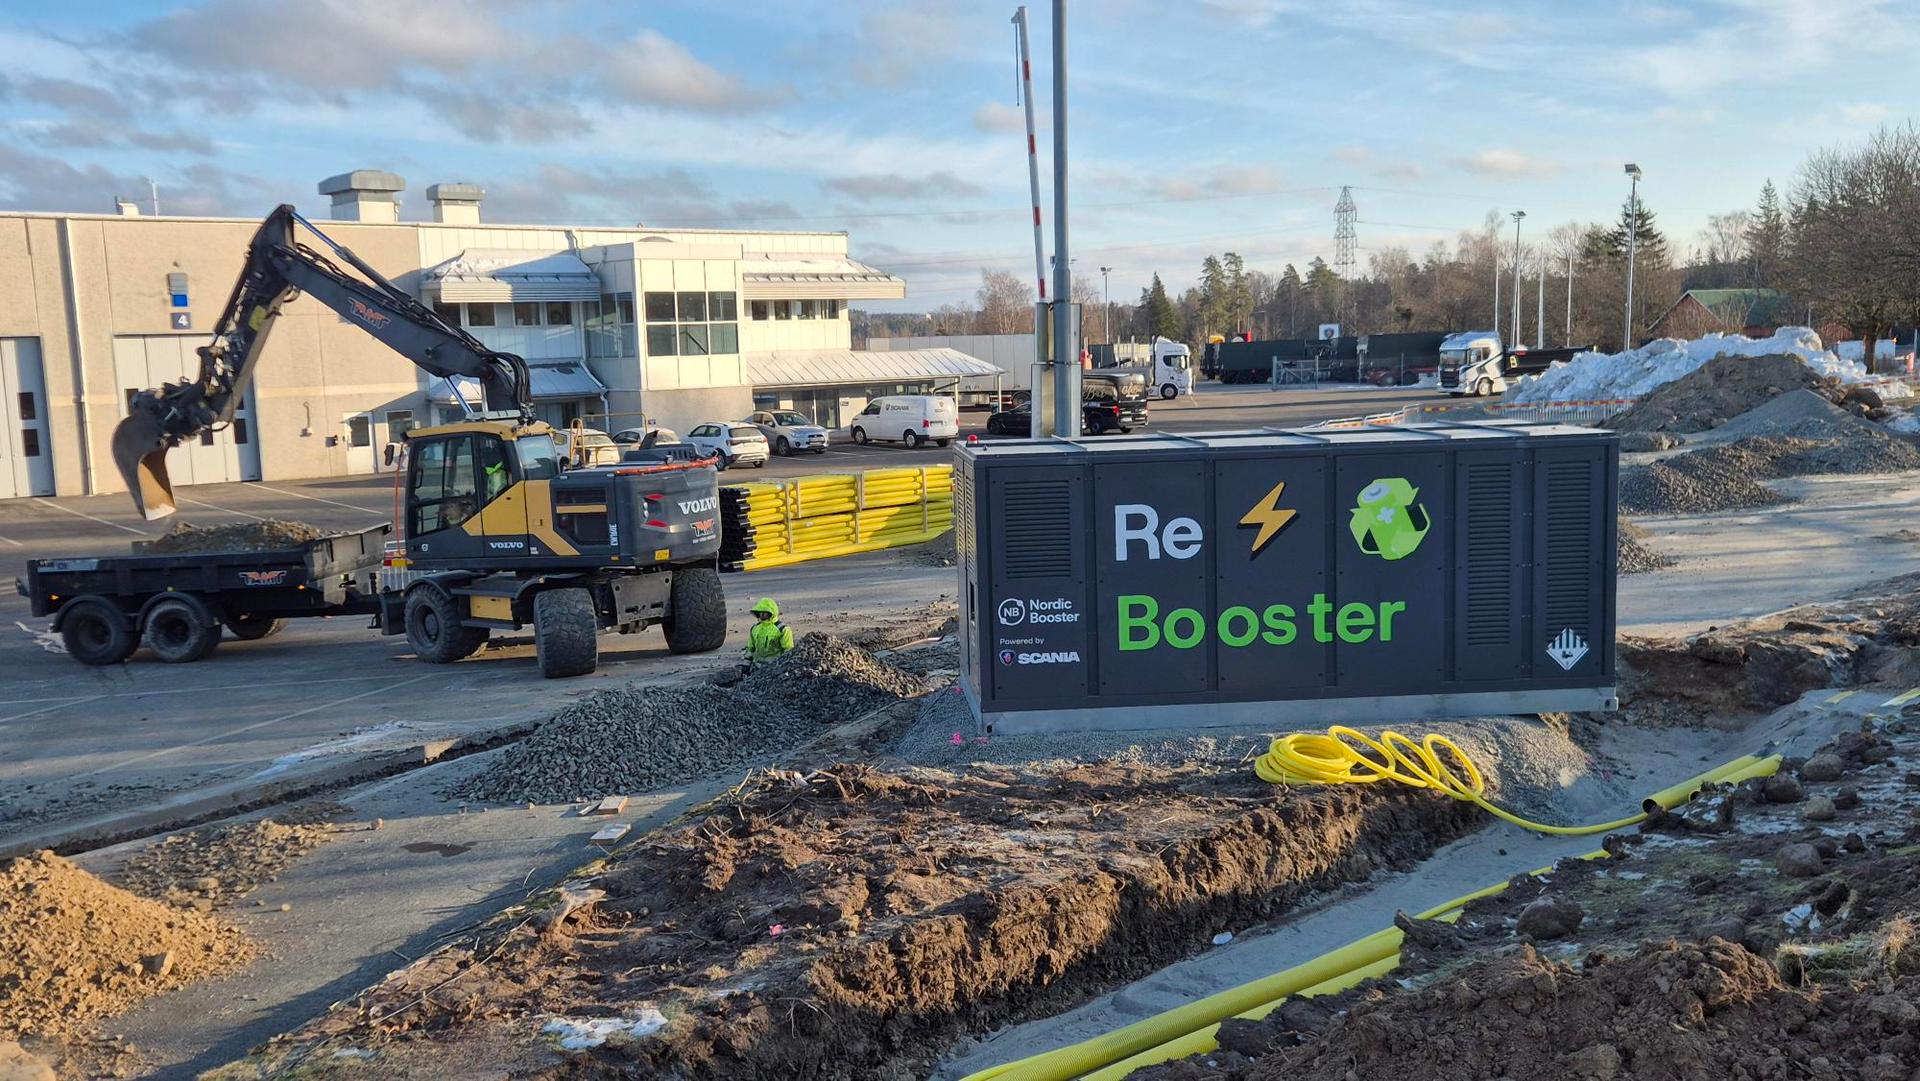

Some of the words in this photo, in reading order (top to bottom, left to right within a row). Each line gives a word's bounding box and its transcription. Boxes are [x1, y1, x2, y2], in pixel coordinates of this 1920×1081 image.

[678, 496, 717, 515] VOLVO
[1114, 504, 1204, 561] Re
[489, 541, 525, 549] VOLVO
[1029, 598, 1073, 611] Nordic
[1003, 607, 1020, 617] NB
[1030, 612, 1080, 624] Booster
[1118, 593, 1406, 650] Booster
[999, 637, 1034, 645] Powered
[1035, 636, 1045, 645] by
[1018, 651, 1081, 664] SCANIA
